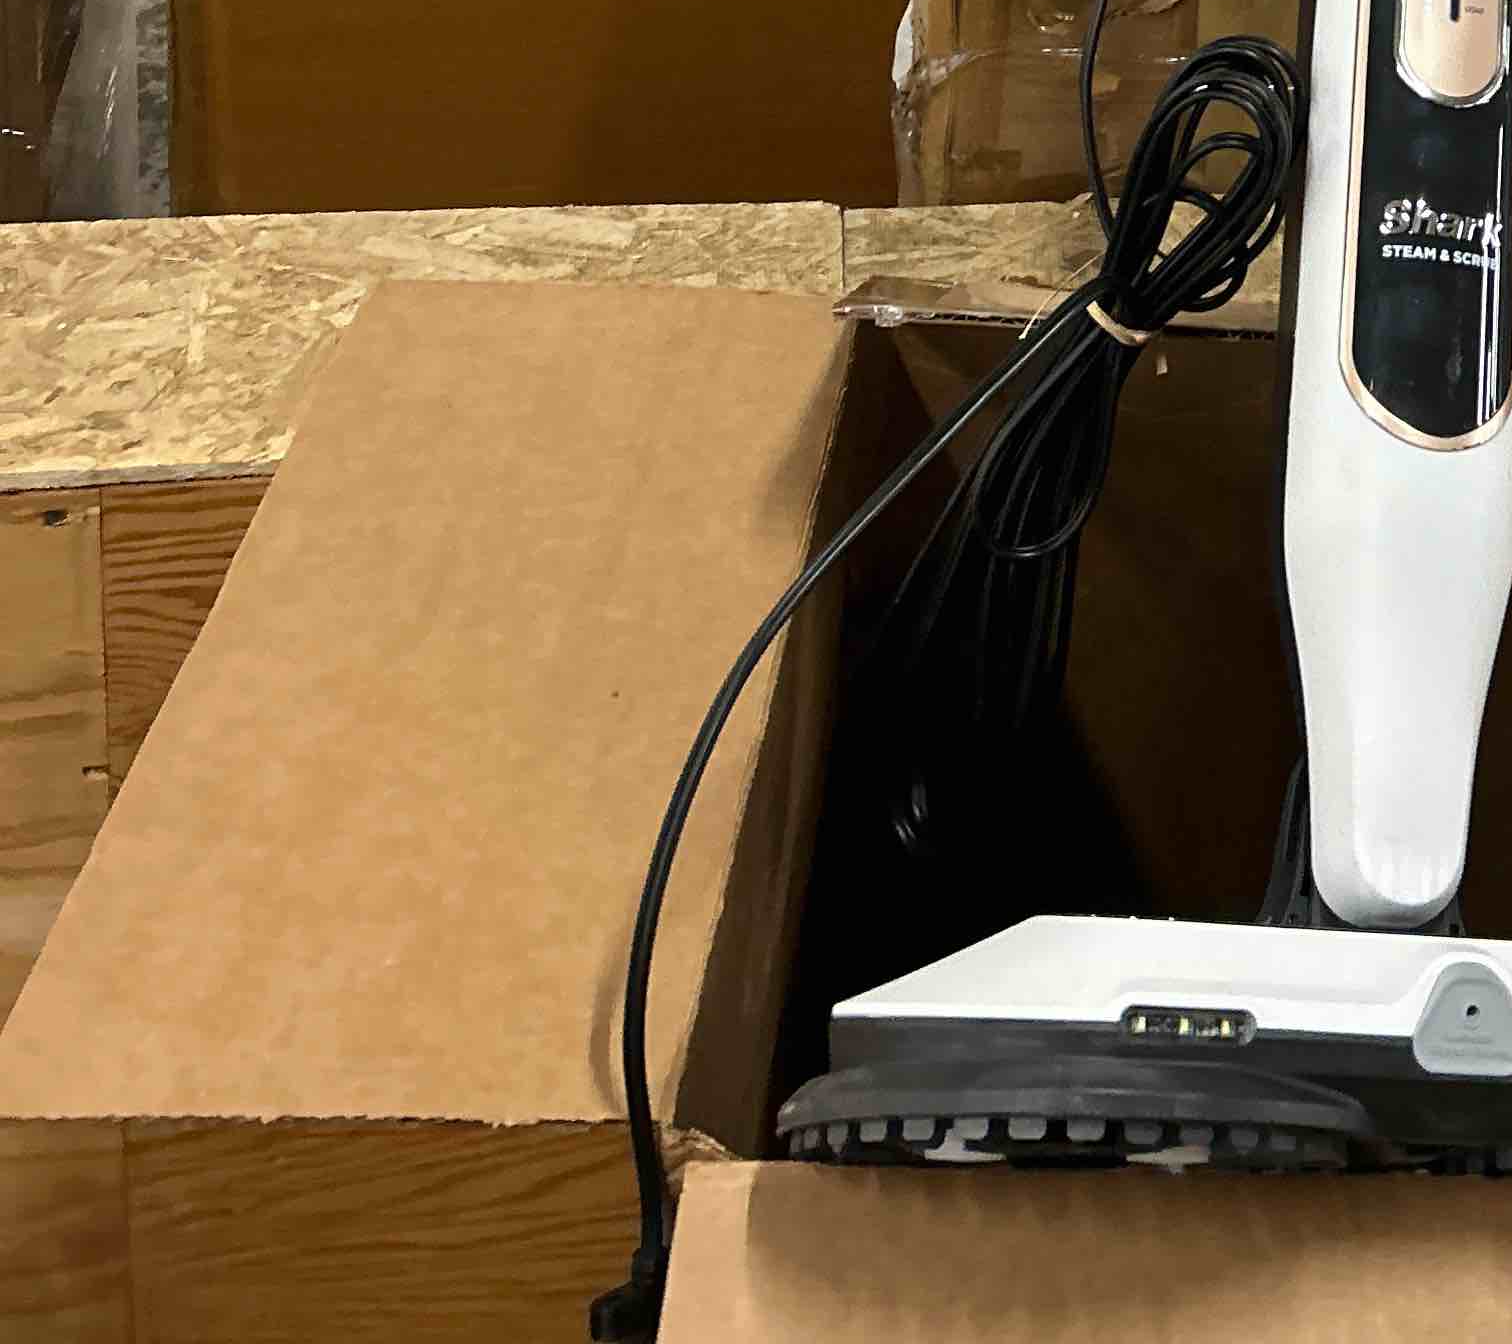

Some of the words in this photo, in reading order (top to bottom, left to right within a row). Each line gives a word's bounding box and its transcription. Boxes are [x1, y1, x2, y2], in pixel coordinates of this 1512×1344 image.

[1379, 196, 1503, 249] Shark
[1382, 244, 1437, 261] STEAM
[1439, 248, 1451, 262] &
